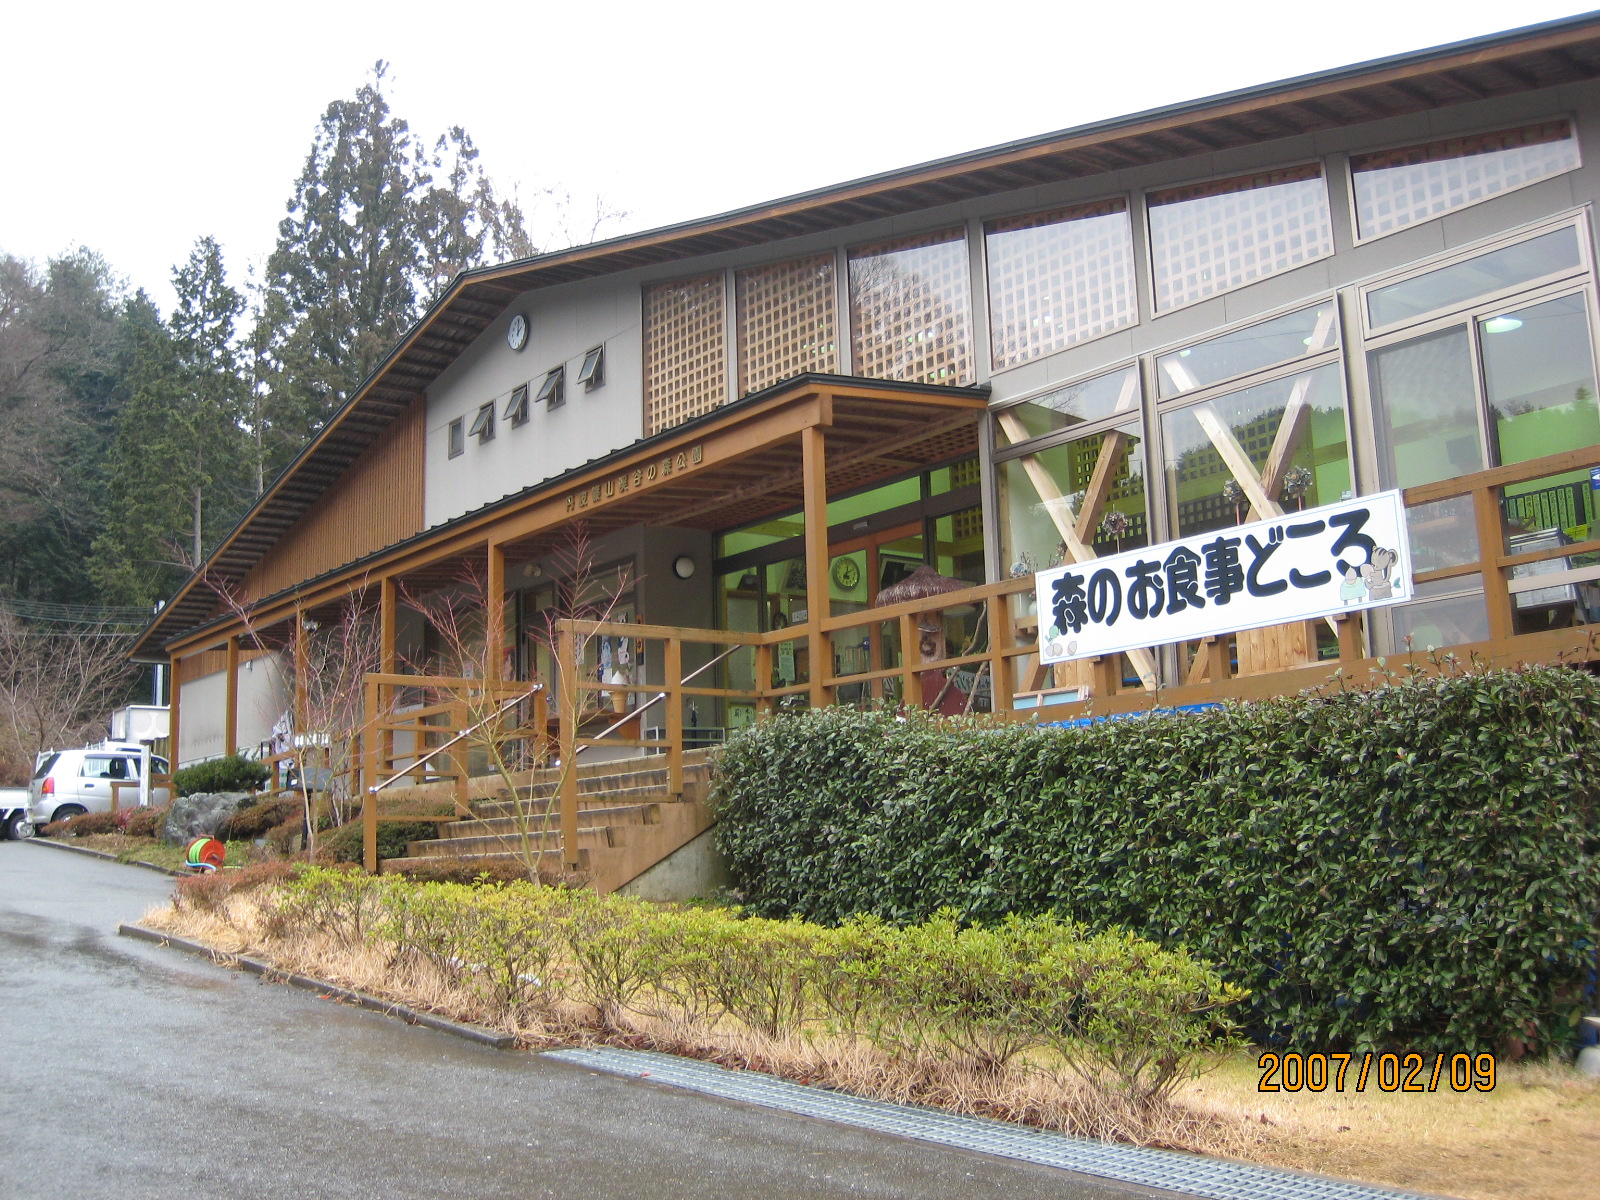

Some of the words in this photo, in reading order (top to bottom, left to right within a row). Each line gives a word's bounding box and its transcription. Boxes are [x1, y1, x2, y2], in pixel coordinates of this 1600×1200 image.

[1051, 508, 1377, 635] 森のお食事どころ
